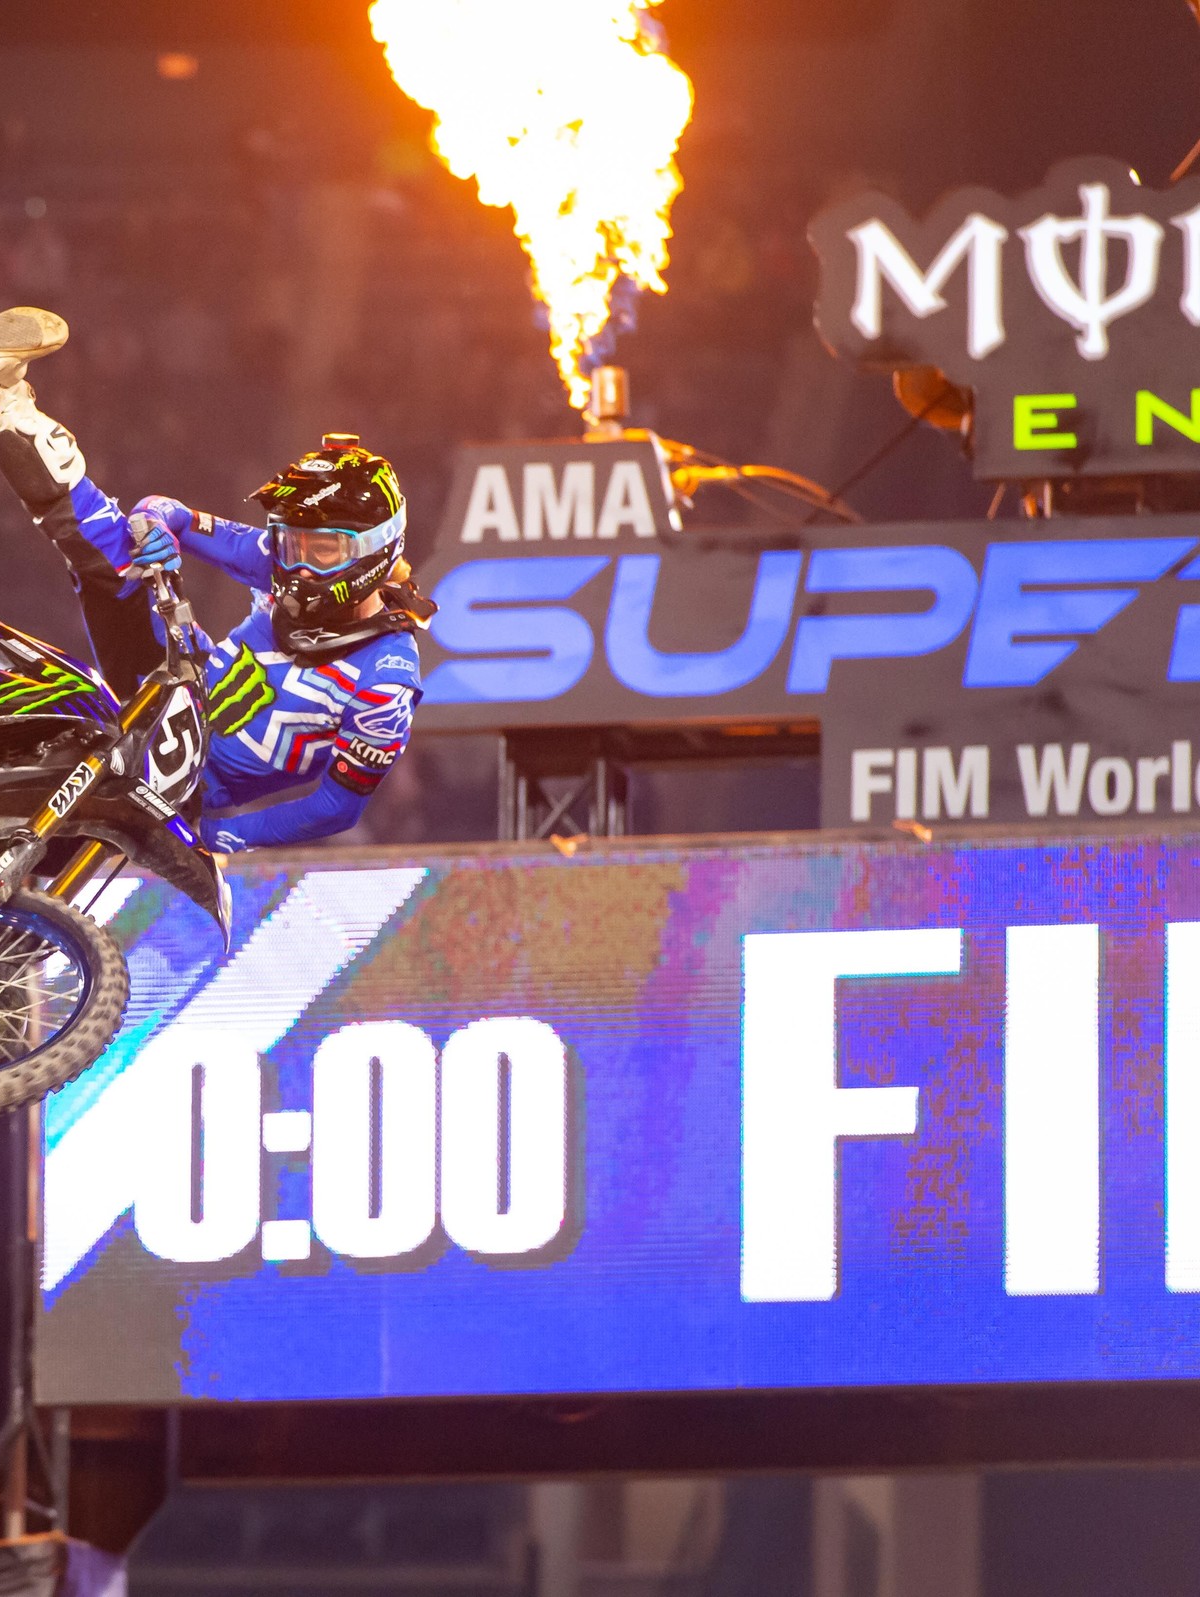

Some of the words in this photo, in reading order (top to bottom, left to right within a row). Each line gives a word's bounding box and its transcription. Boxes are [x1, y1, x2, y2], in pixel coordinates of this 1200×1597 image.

[846, 183, 1200, 360] MO
[461, 461, 657, 542] AMA
[420, 537, 1200, 704] SUPE
[50, 763, 94, 816] KYB
[143, 792, 176, 818] YAMAHA
[851, 745, 990, 821] FIM
[1016, 739, 1200, 817] Worl
[740, 920, 1200, 1303] FI
